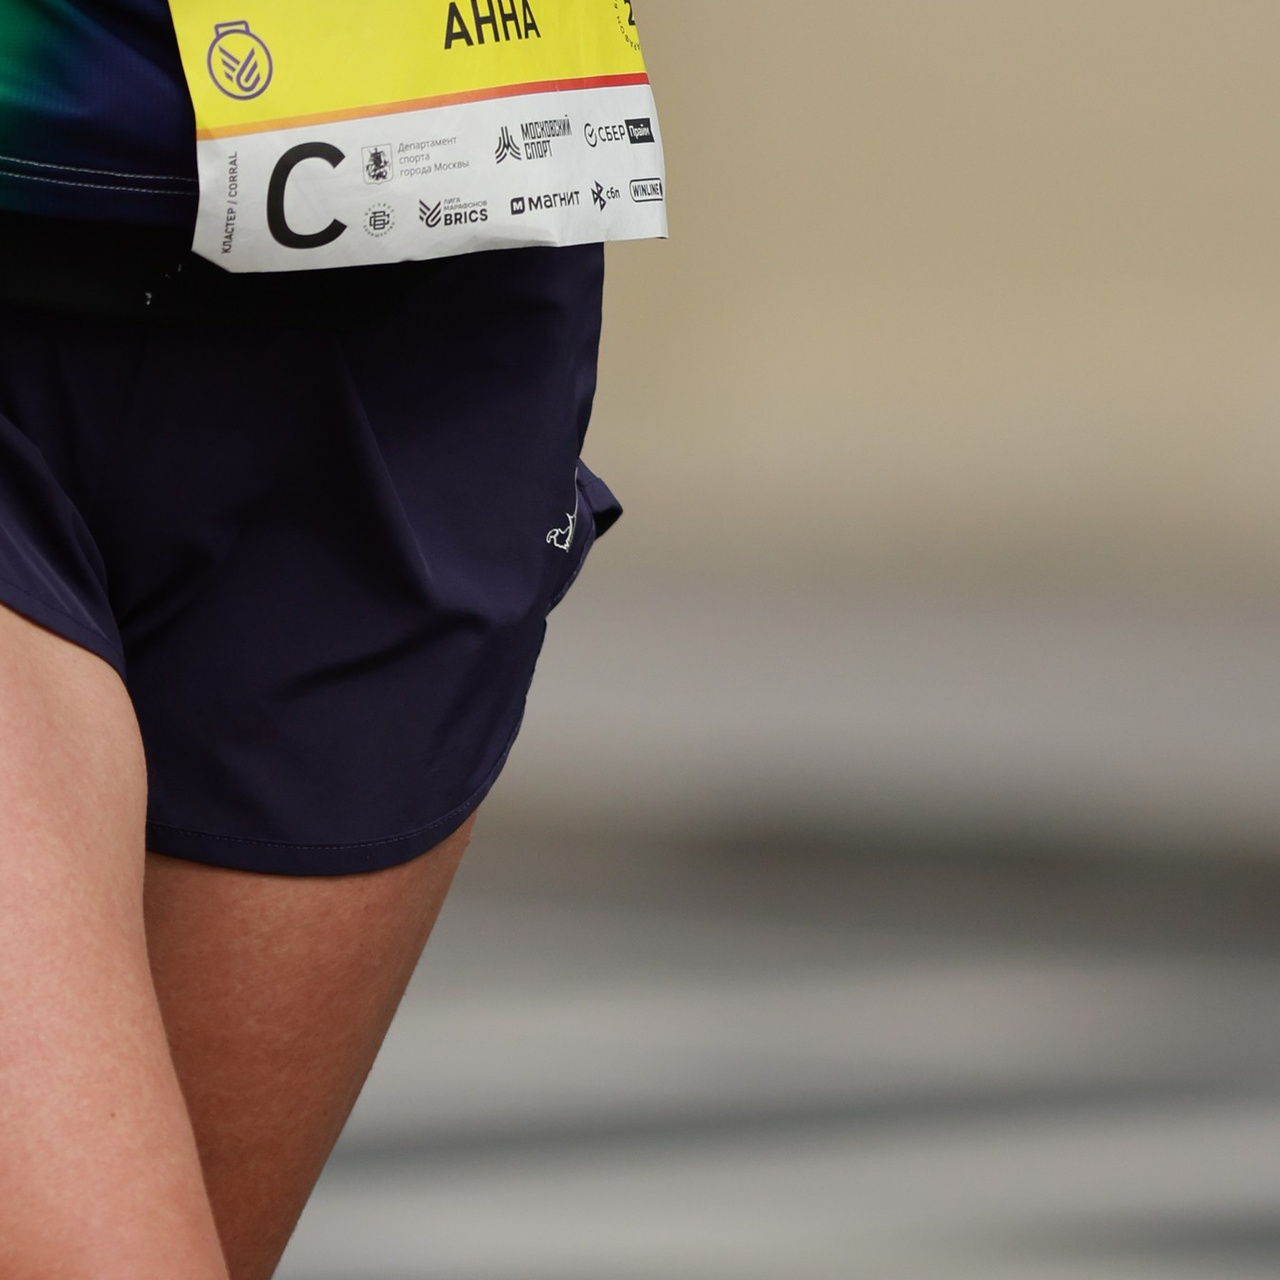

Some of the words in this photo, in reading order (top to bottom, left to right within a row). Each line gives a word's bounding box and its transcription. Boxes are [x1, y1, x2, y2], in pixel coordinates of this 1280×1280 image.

[520, 114, 572, 141] МОСКОВСКИЙ
[598, 124, 626, 142] СБЕР
[398, 137, 457, 154] Департамент
[524, 139, 553, 160] СПОРТ
[399, 153, 430, 165] спорта
[228, 151, 238, 197] CORRAL
[400, 166, 432, 177] города
[433, 160, 469, 172] Москвы
[606, 187, 621, 200] сбп
[632, 183, 660, 197] WINLINE
[443, 208, 488, 226] BRICS
[221, 207, 236, 254] КЛАСТЕР
